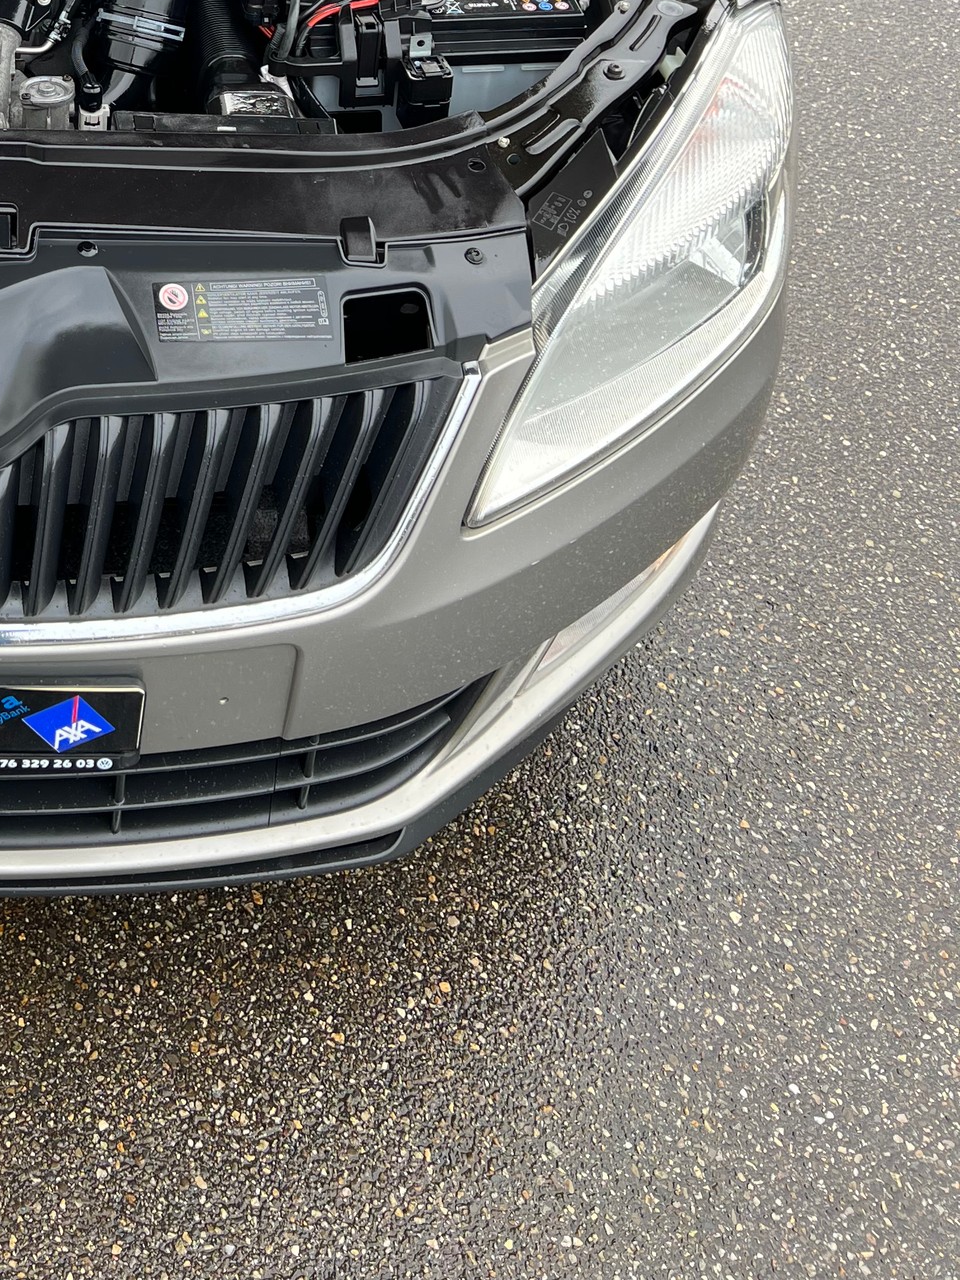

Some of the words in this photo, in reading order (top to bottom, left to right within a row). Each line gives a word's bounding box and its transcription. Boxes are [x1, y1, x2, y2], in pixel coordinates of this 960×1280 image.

[54, 720, 102, 750] AXA
[21, 758, 50, 769] 329
[53, 758, 72, 769] 26
[76, 758, 95, 769] 03
